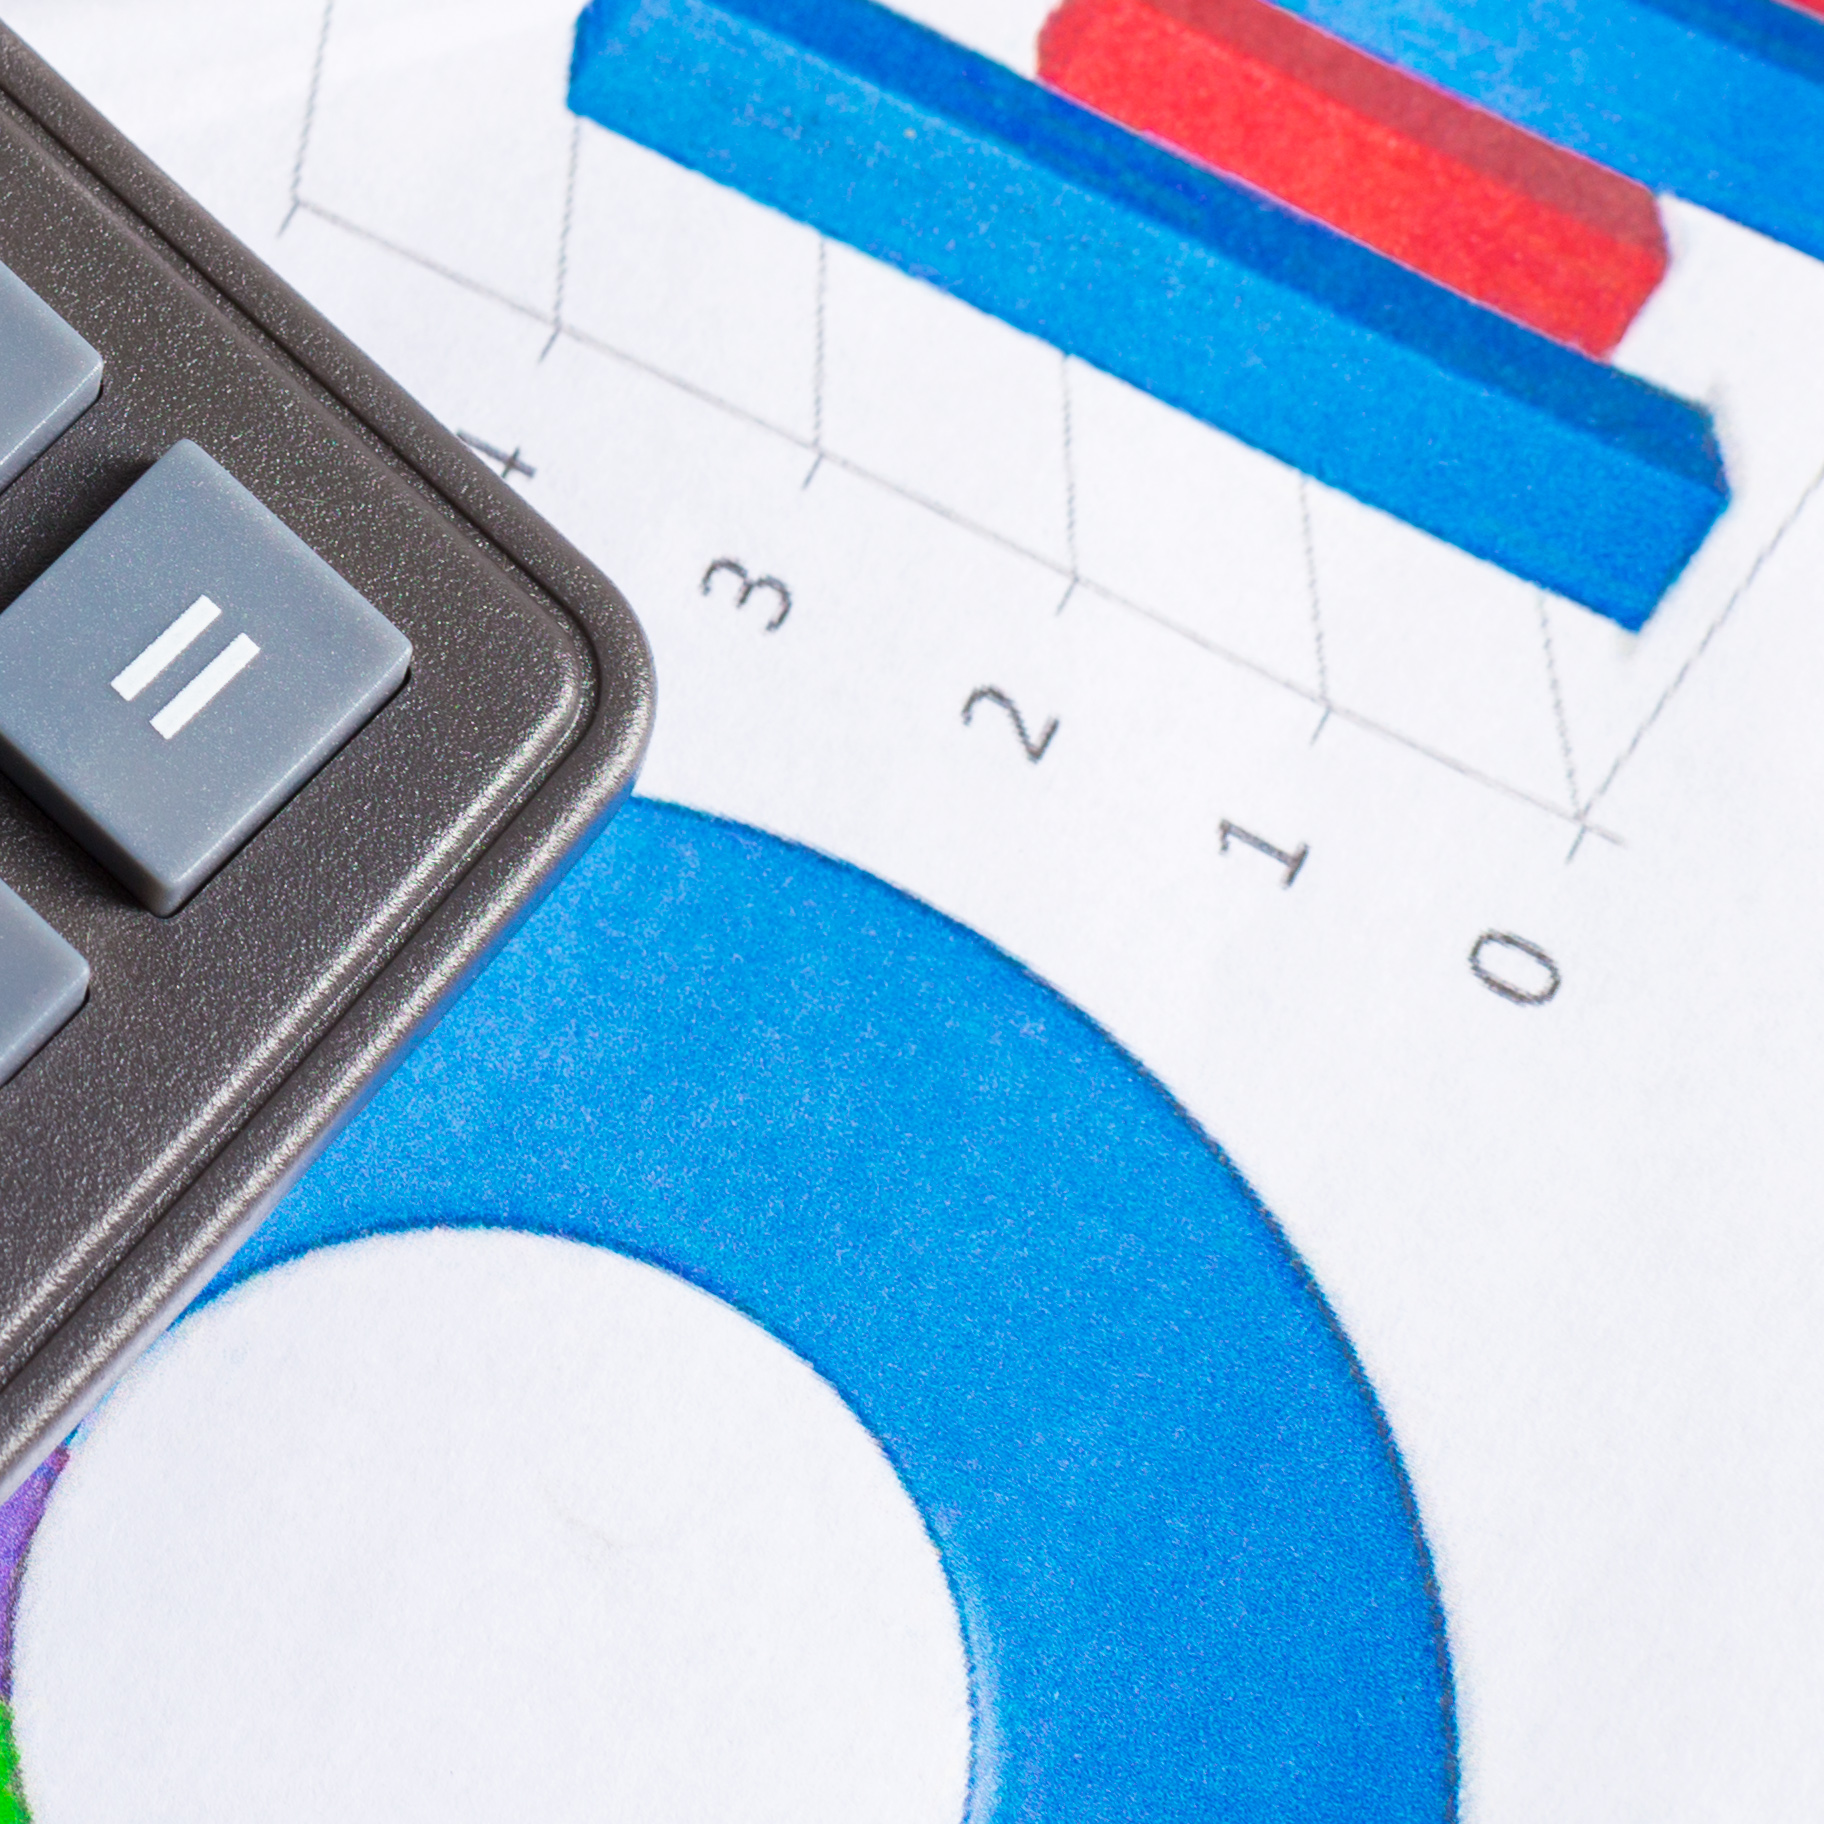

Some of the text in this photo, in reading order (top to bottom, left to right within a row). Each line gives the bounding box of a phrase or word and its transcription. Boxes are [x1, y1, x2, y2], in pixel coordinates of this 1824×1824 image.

[702, 559, 792, 631] 3
[962, 687, 1059, 763] 2
[1220, 820, 1308, 886] 1
[1468, 933, 1561, 1005] 0
